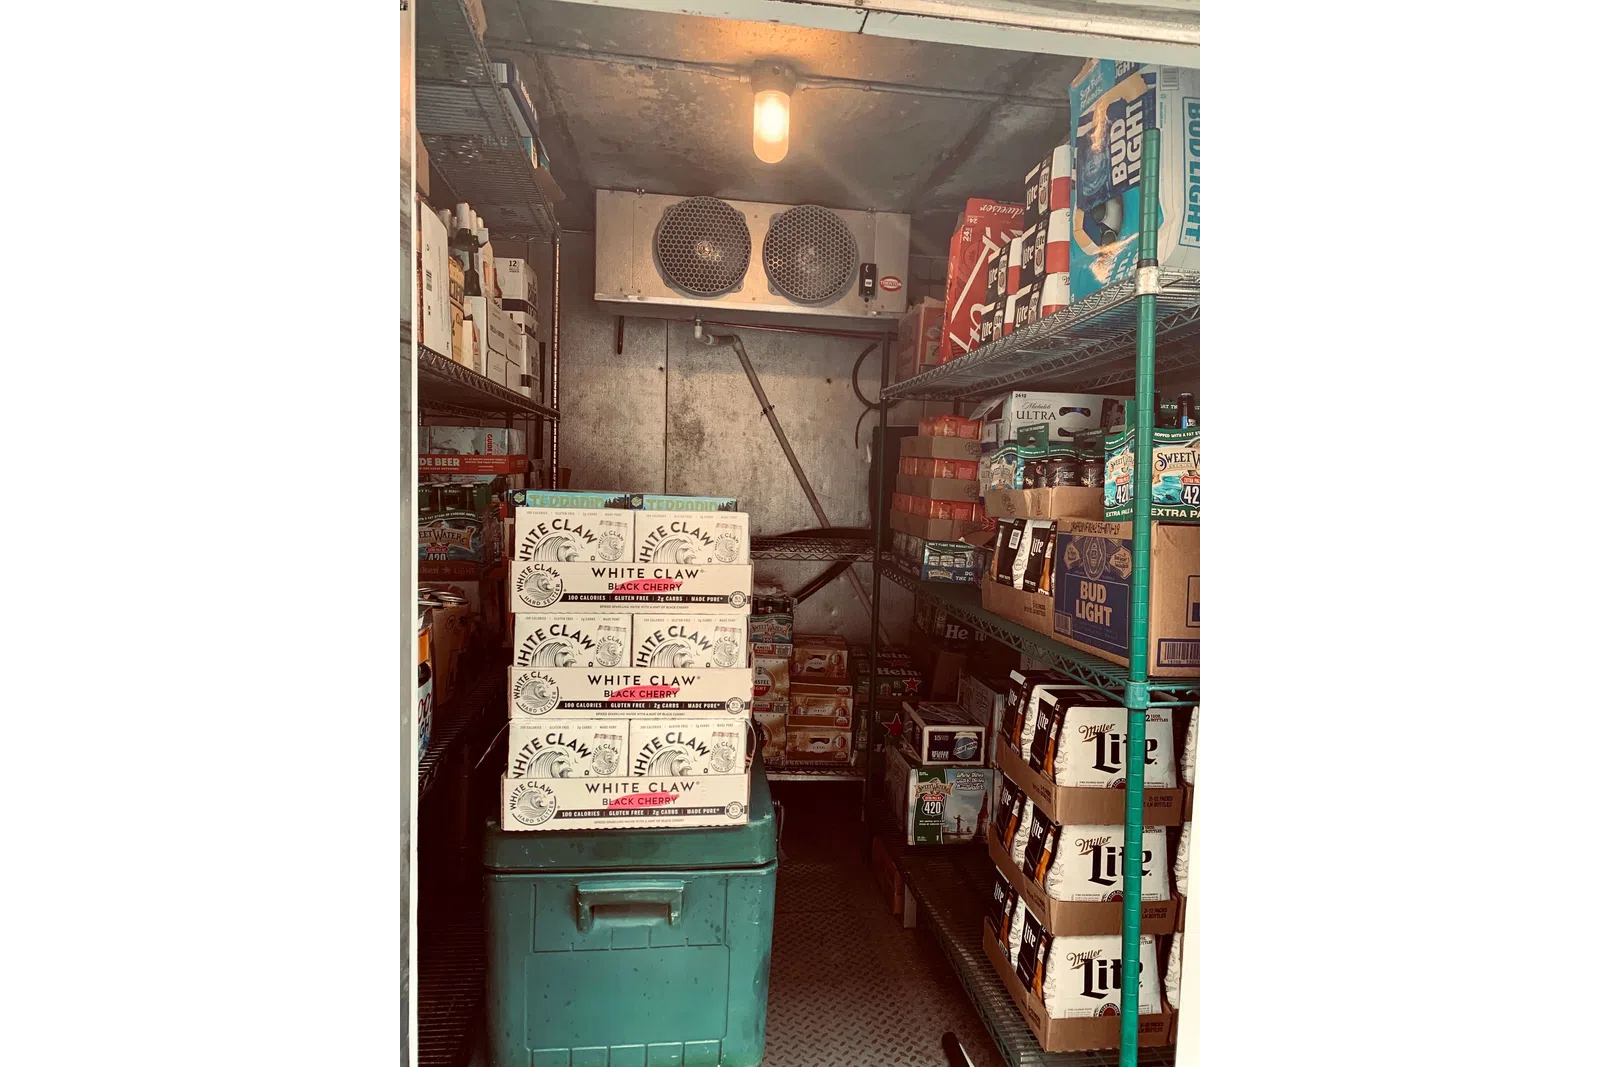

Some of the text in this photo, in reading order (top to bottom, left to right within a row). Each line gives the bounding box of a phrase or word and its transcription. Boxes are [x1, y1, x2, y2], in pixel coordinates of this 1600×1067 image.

[1111, 119, 1127, 186] BUD
[1126, 100, 1143, 185] LIGHT
[1026, 185, 1038, 210] Lite
[980, 204, 1024, 219] dweiser
[1023, 246, 1035, 269] Lite
[1016, 306, 1029, 328] Lite
[982, 322, 993, 341] Lite
[1016, 411, 1056, 420] ULTRA
[435, 458, 460, 467] BEER
[1106, 510, 1120, 518] EXTRA
[1151, 509, 1187, 518] EXTRA
[552, 519, 598, 544] CLAW
[671, 522, 714, 546] CLAW
[1030, 538, 1044, 556] Lite
[517, 564, 560, 593] WHITE CLAW
[592, 568, 699, 579] WHITE CLAW
[524, 584, 561, 606] HARD SELTZER
[608, 583, 682, 591] BLACK CHERRY
[1080, 581, 1107, 604] BUD
[1076, 600, 1112, 627] LIGHT
[550, 624, 596, 650] CLAW
[668, 626, 713, 651] CLAW
[588, 675, 696, 686] WHITE CLAW
[877, 668, 921, 676] Hein
[514, 671, 556, 700] WHITE CLAW
[604, 690, 679, 698] BLACK CHERRY
[521, 692, 557, 713] HARD SELTZER
[1037, 710, 1049, 730] Lite
[1079, 724, 1116, 743] Miller
[546, 733, 592, 759] CLAW
[666, 732, 710, 757] CLAW
[510, 781, 553, 811] WHITE CLAW
[586, 782, 694, 794] WHITE CLAW
[518, 800, 554, 823] HARD SELTZER
[603, 797, 678, 806] BLACK CHERRY
[924, 802, 941, 814] 420
[1032, 816, 1044, 839] Lite
[1075, 836, 1112, 856] Miller
[994, 882, 1004, 903] Lite
[1024, 922, 1036, 948] Lite
[1066, 949, 1103, 970] Miller
